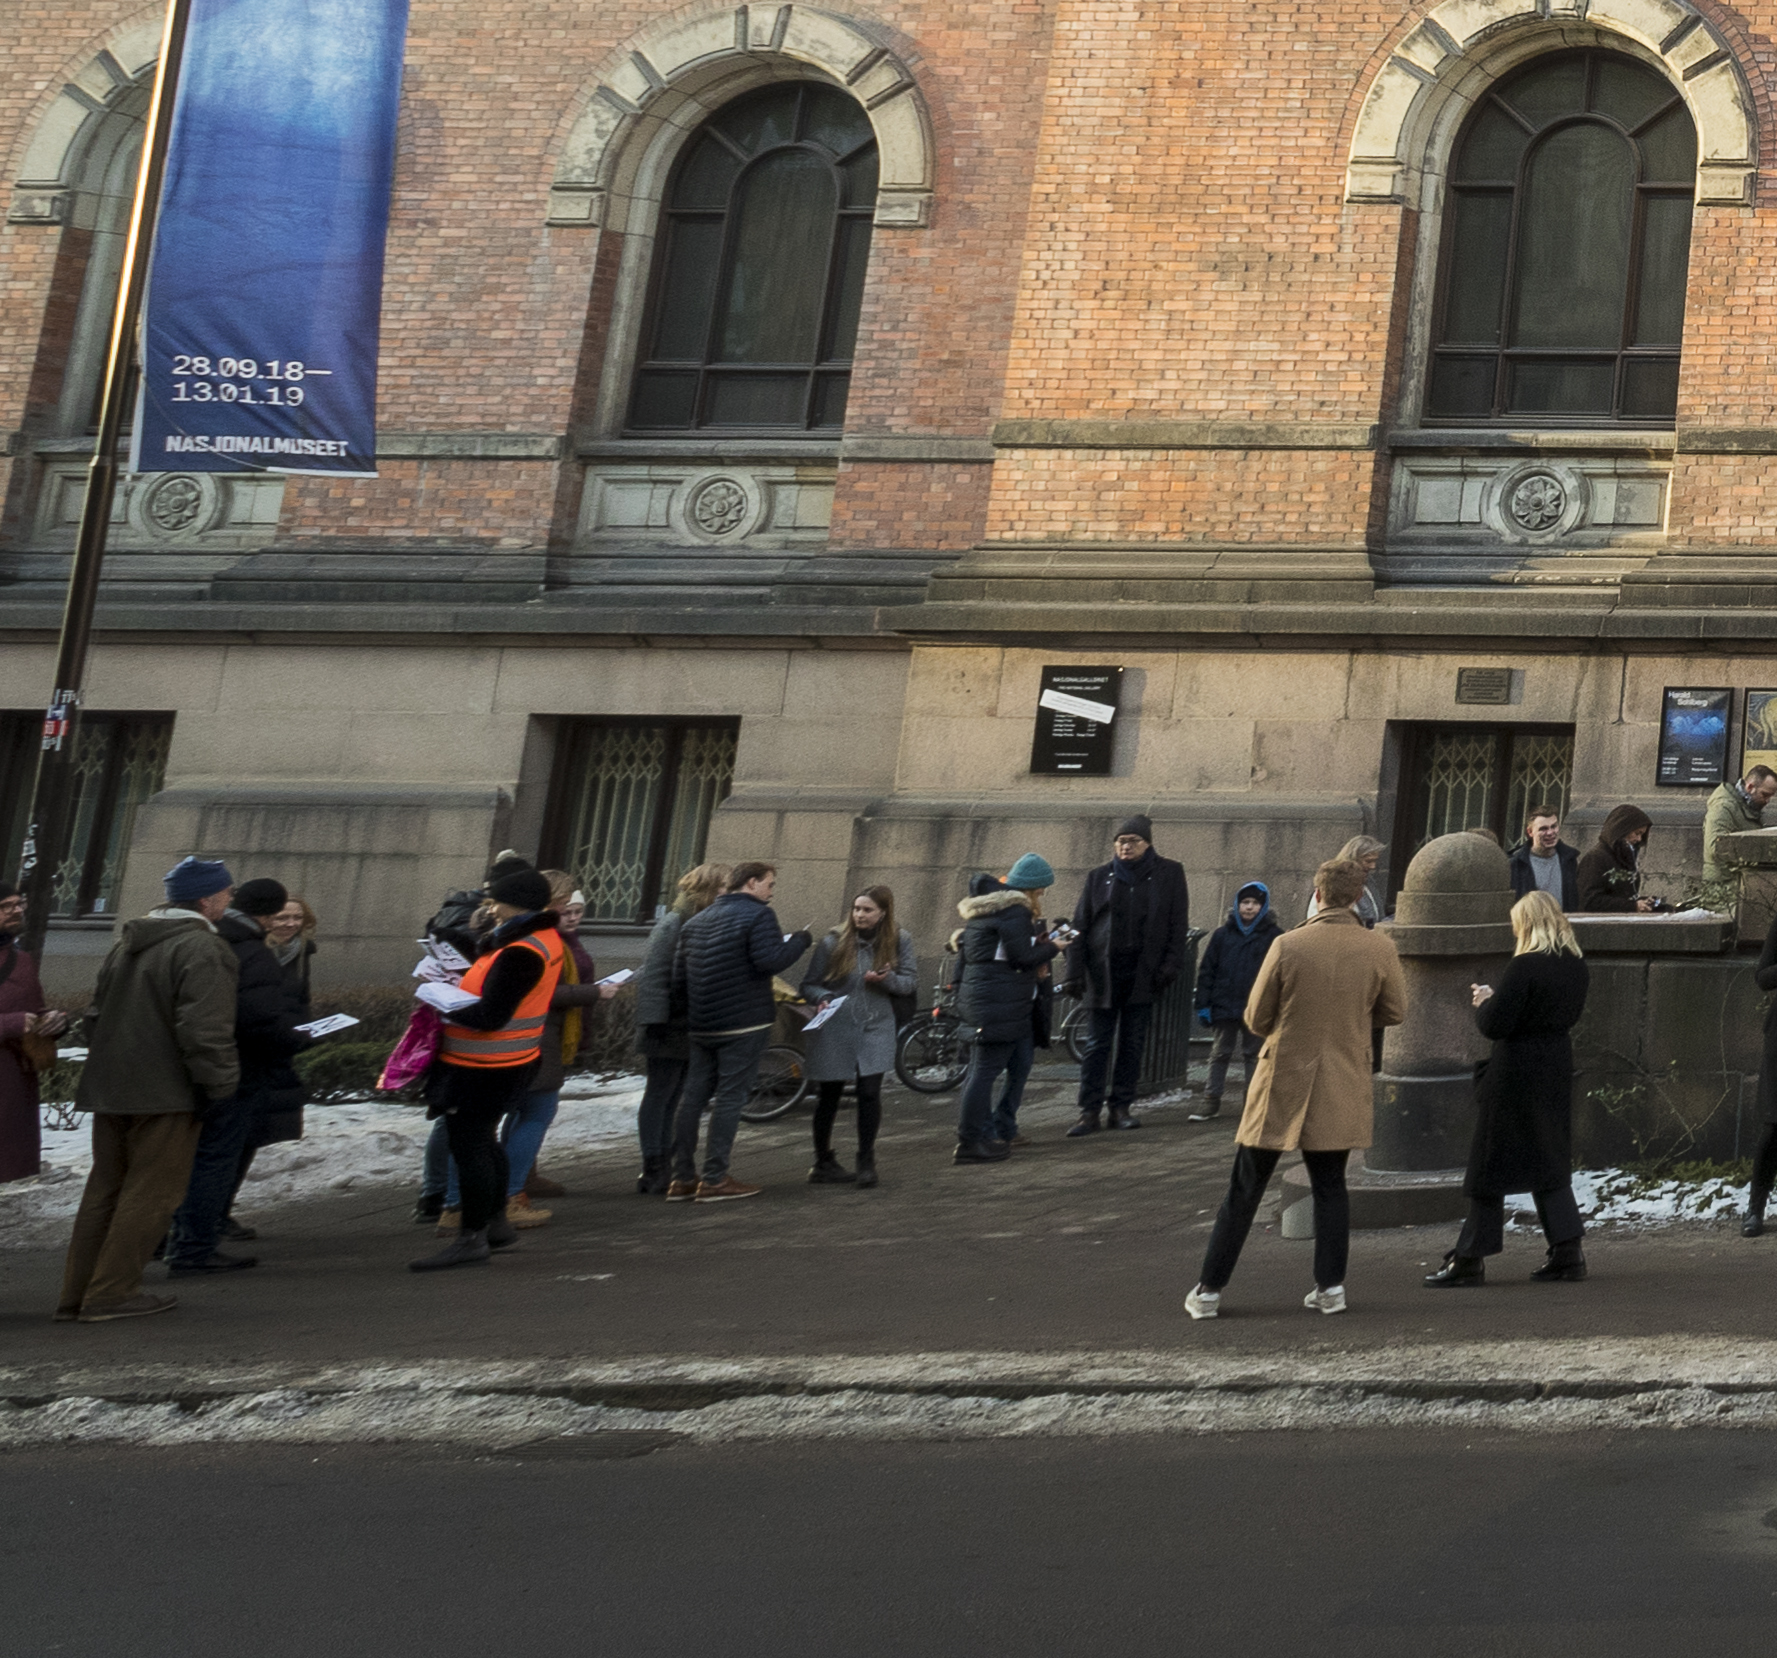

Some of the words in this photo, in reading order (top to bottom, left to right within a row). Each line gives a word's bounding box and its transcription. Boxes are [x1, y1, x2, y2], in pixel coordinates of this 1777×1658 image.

[171, 381, 305, 407] 13.01.19
[165, 435, 349, 457] NASJONALMUSEET
[1668, 691, 1691, 699] Harald
[1677, 698, 1708, 708] Sohlberg
